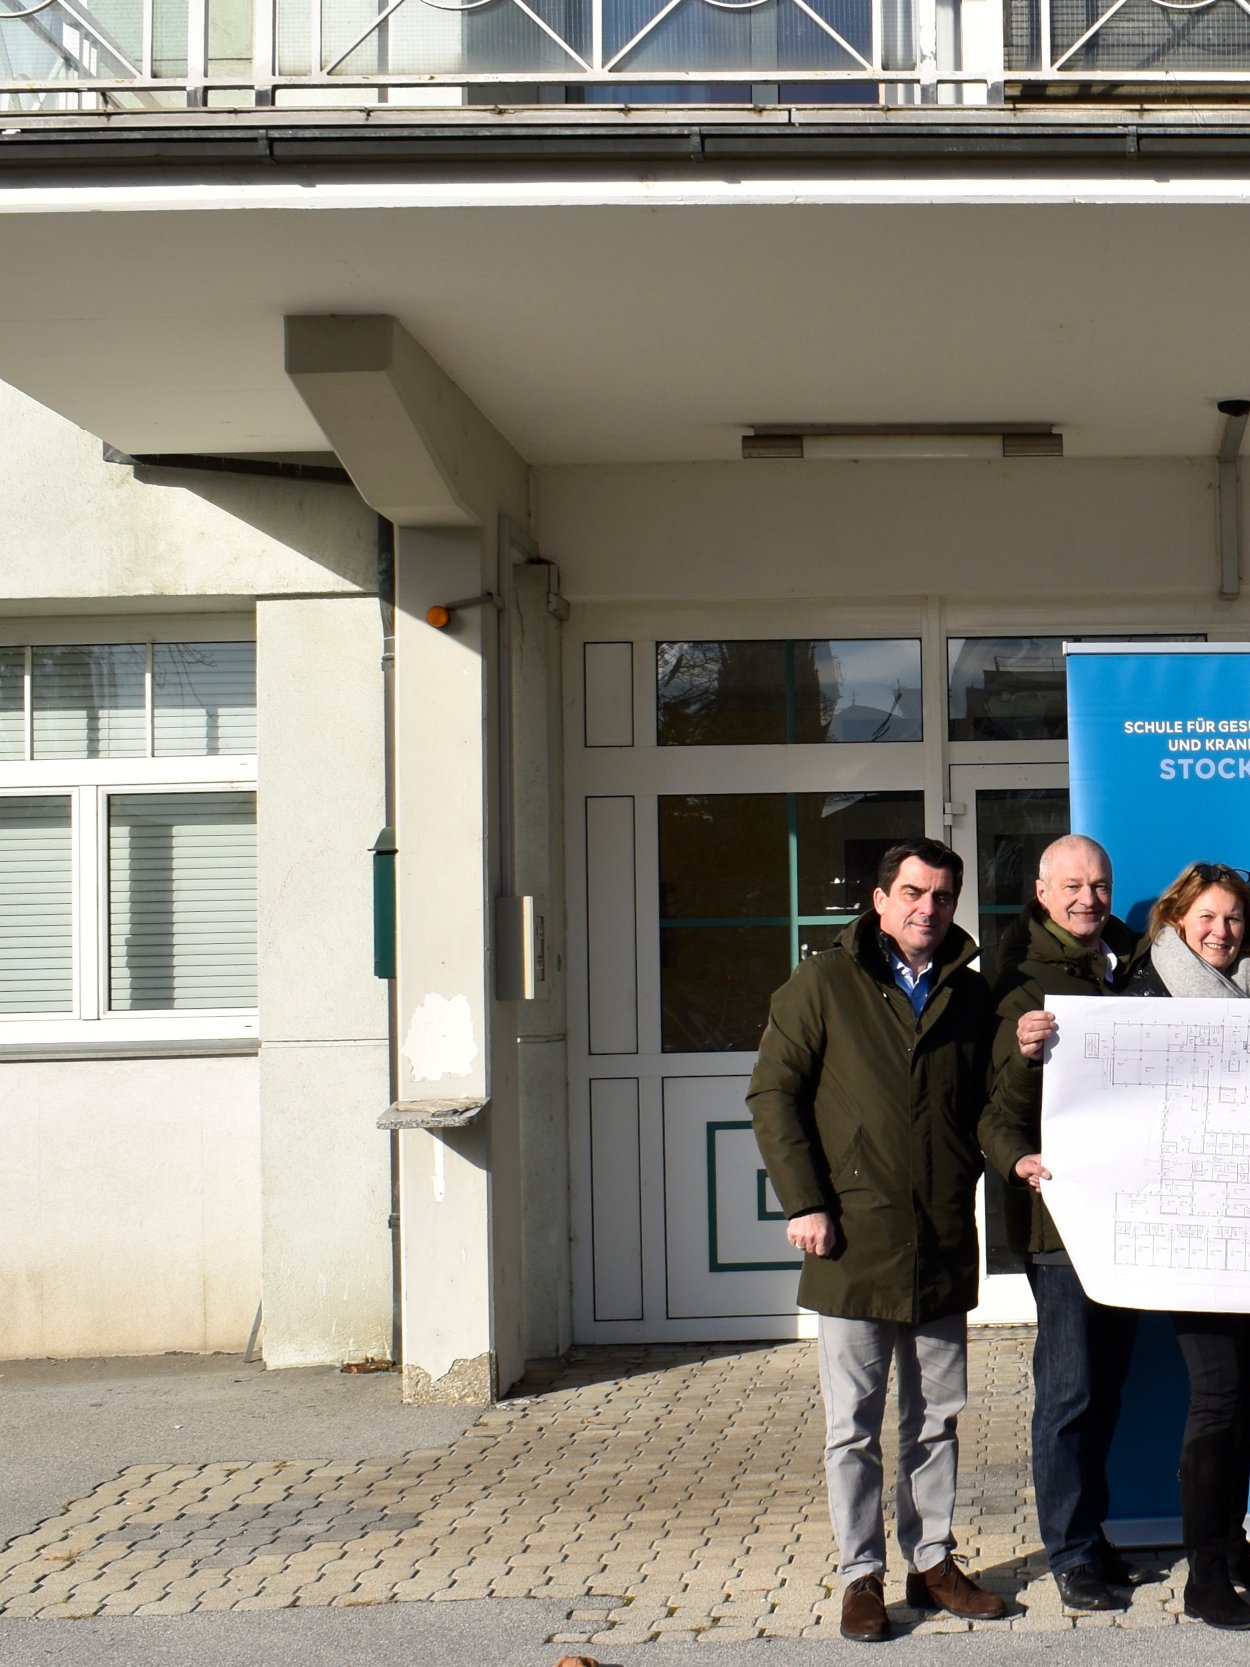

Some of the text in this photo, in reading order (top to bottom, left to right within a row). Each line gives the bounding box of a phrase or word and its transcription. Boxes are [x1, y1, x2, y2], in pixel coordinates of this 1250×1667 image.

[1124, 720, 1183, 734] SCHULE
[1187, 717, 1215, 733] FÜR
[1168, 739, 1201, 752] UND
